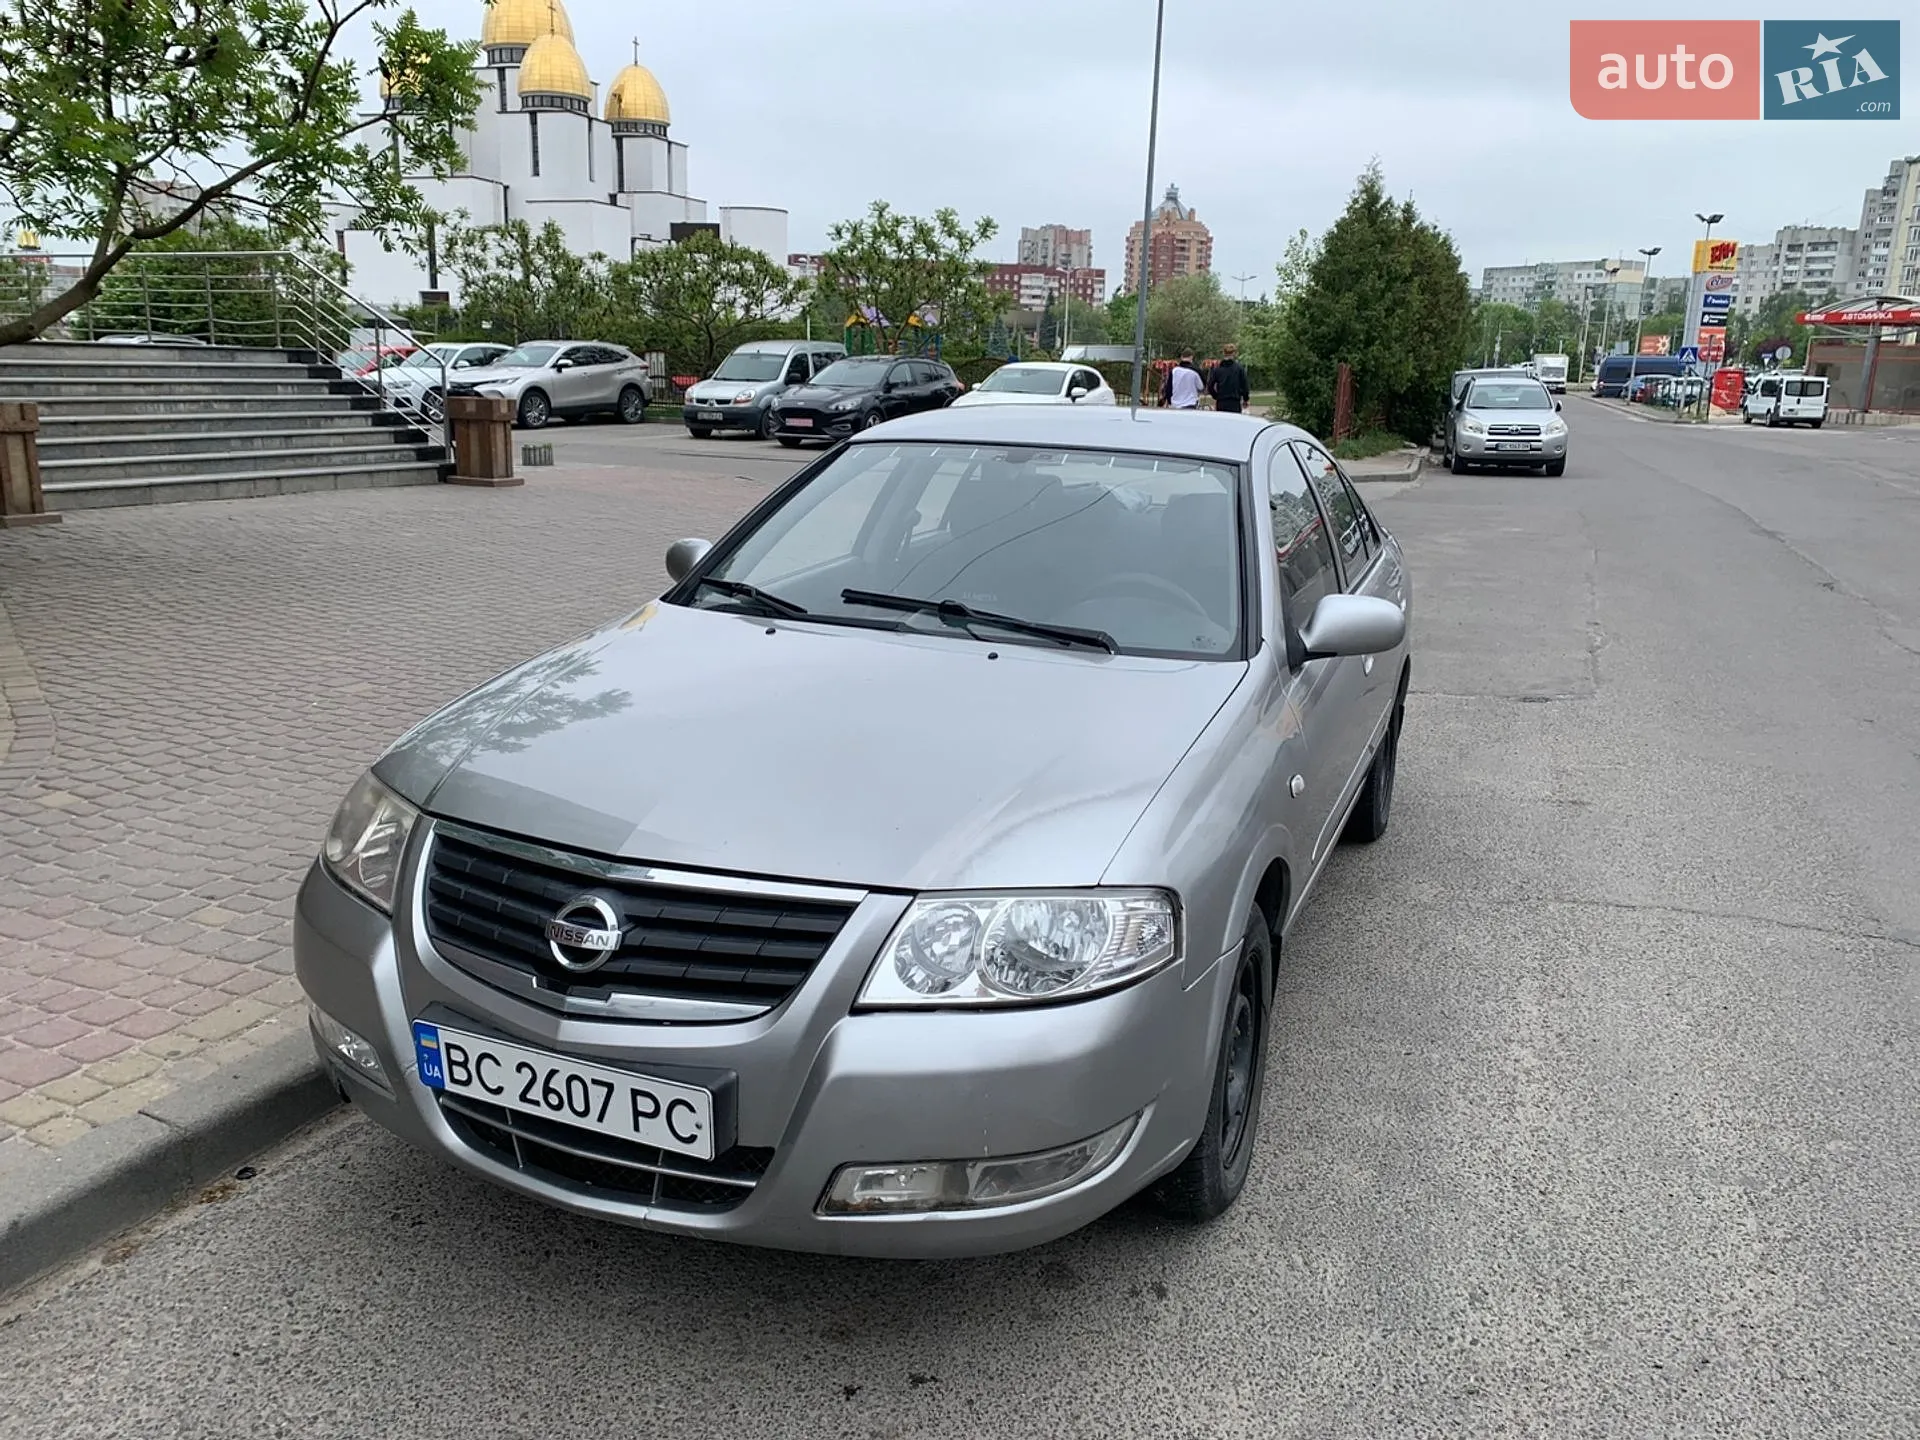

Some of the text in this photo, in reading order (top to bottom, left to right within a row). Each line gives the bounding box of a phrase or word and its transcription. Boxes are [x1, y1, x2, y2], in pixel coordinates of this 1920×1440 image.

[550, 925, 610, 948] NISSAN
[423, 1061, 442, 1079] UA
[443, 1041, 698, 1145] BC 2607 PC
